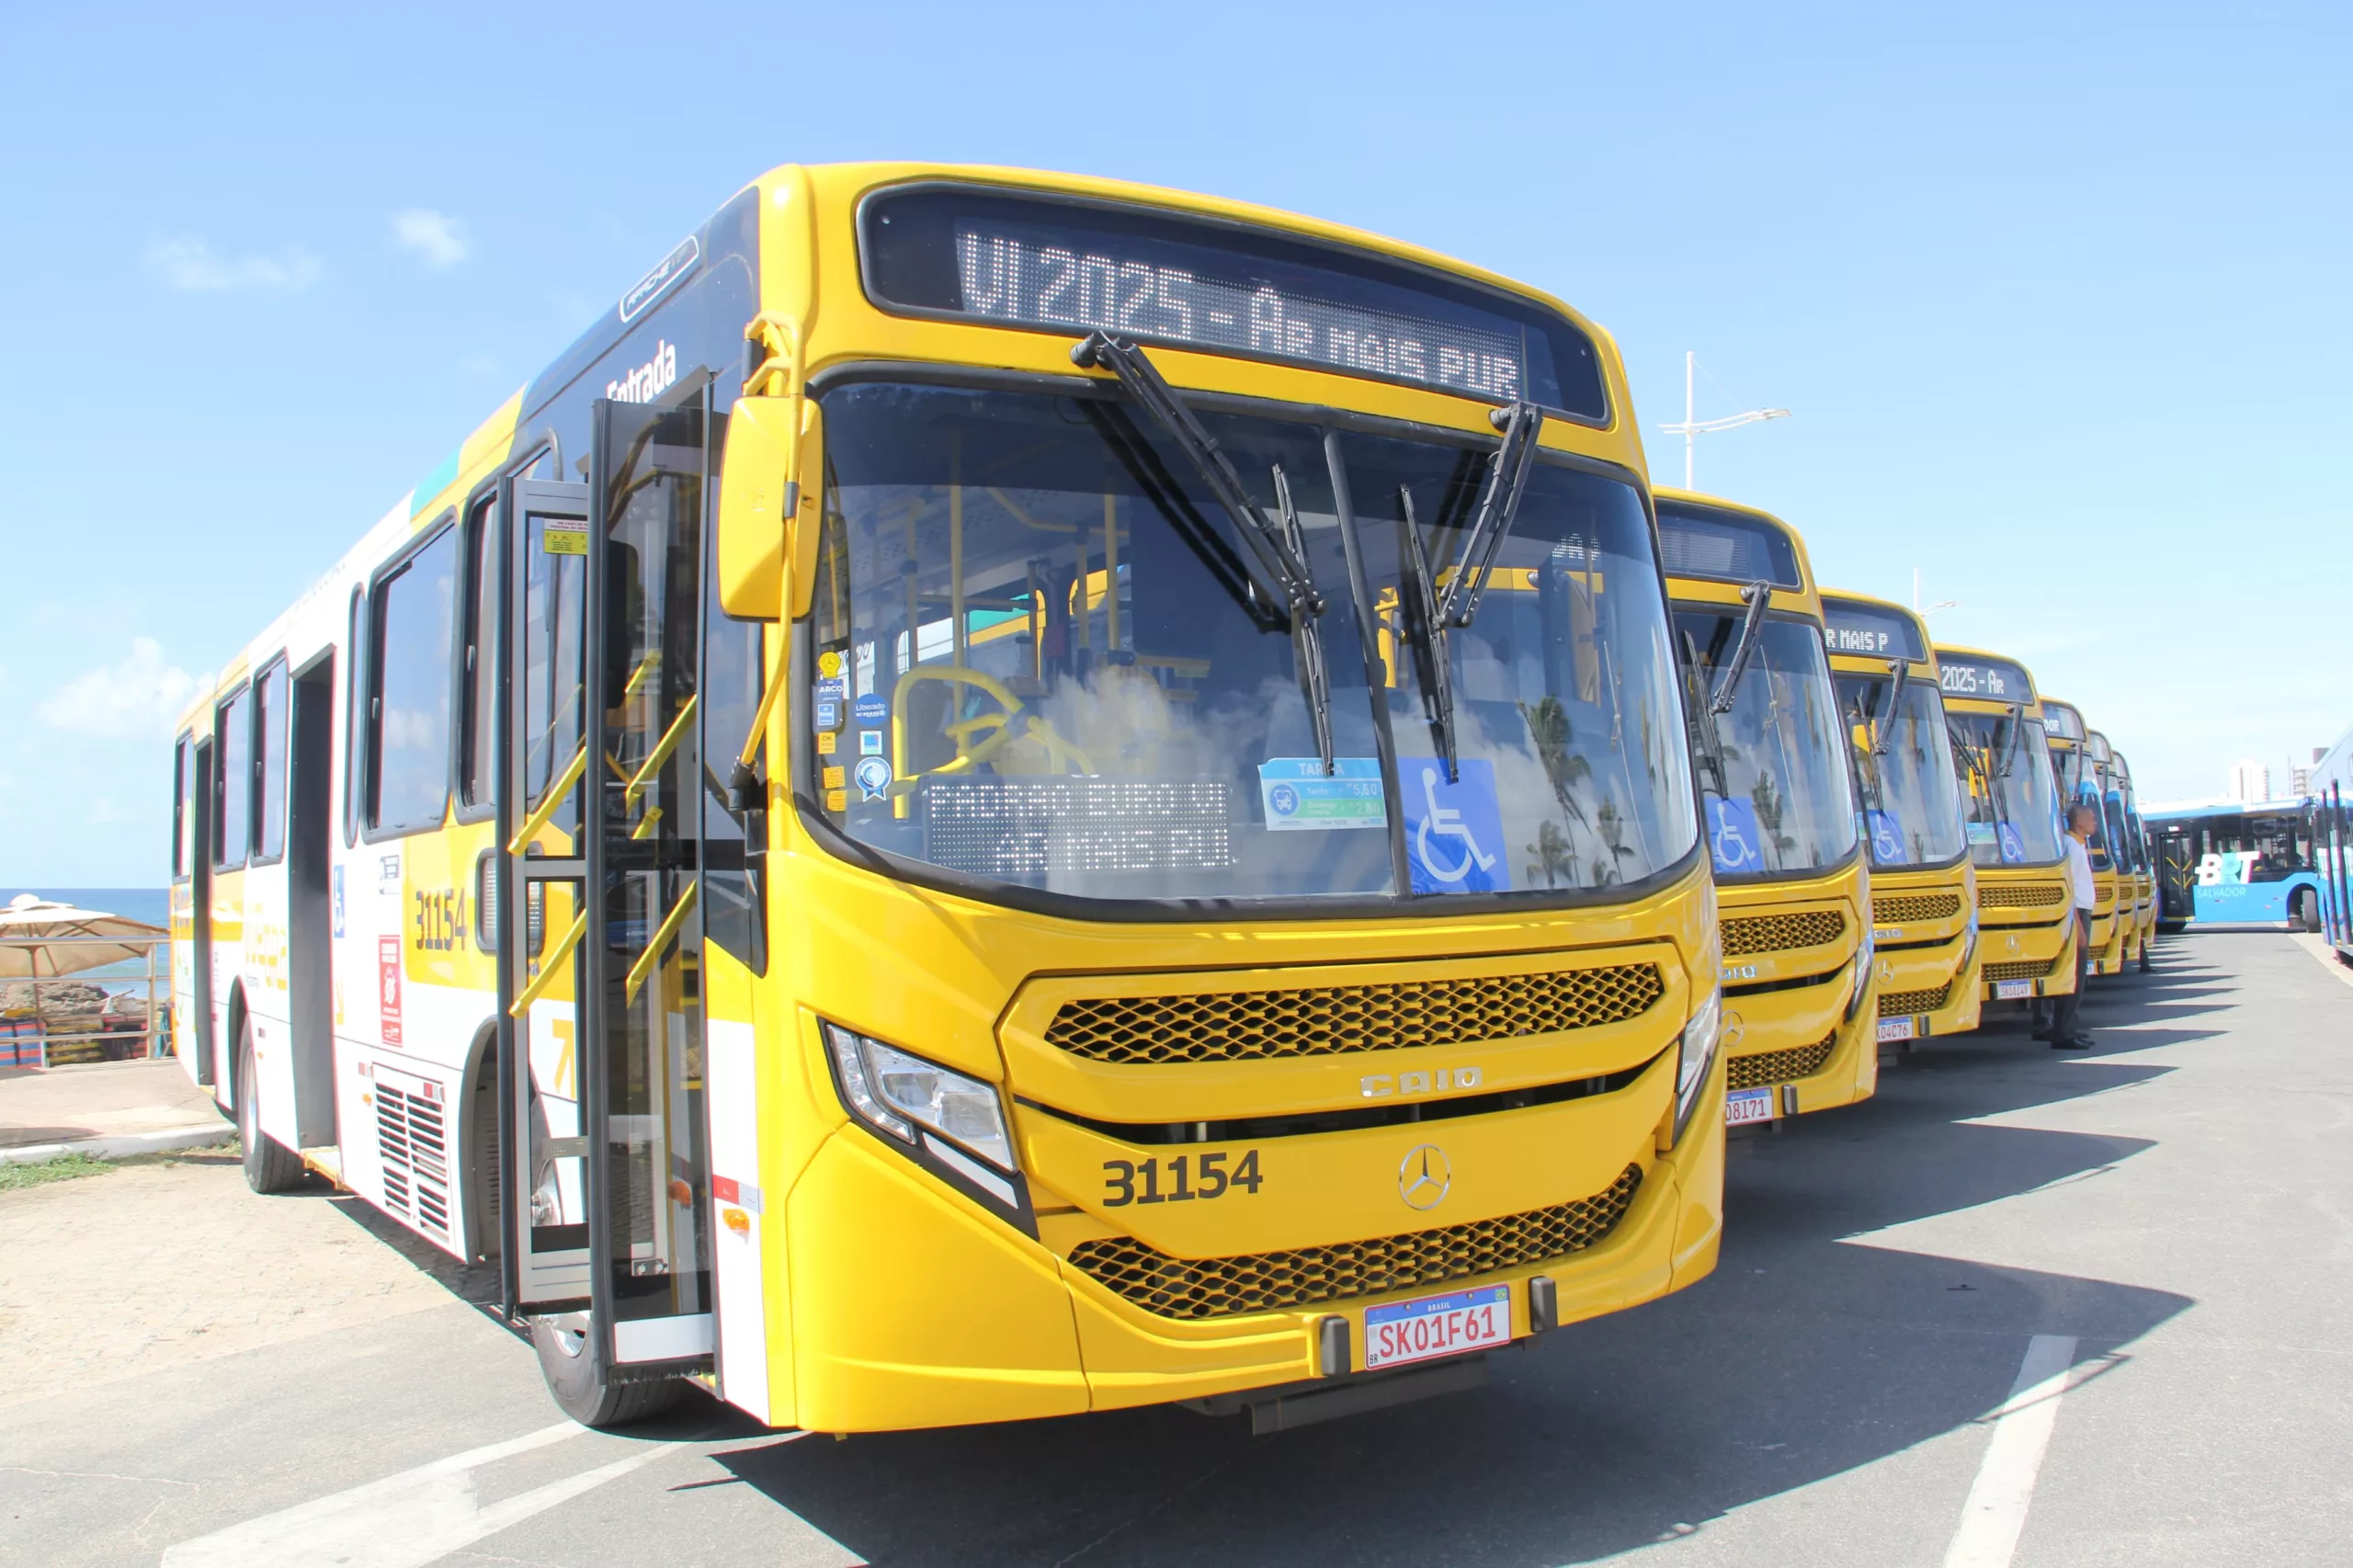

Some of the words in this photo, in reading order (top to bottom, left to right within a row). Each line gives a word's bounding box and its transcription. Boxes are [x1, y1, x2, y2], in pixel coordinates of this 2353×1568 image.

[1039, 246, 1193, 341] 2025
[1839, 629, 1875, 651] MAIS
[819, 685, 843, 693] ARCO
[1941, 665, 1977, 693] 2025
[856, 703, 886, 711] Liberado
[1298, 763, 1345, 776] TARA
[1088, 784, 1175, 816] EURO
[1353, 783, 1378, 796] 5,60
[1066, 830, 1154, 870] MAIS
[1171, 828, 1228, 869] PU
[2194, 850, 2261, 886] BRT
[2197, 887, 2246, 898] SALVADOR
[415, 887, 467, 952] 31154
[1721, 965, 1756, 980] AIO
[1360, 1066, 1483, 1097] CAIO
[1102, 1149, 1264, 1208] 31154
[1427, 1301, 1451, 1312] BRASIL
[1369, 1354, 1379, 1365] BR
